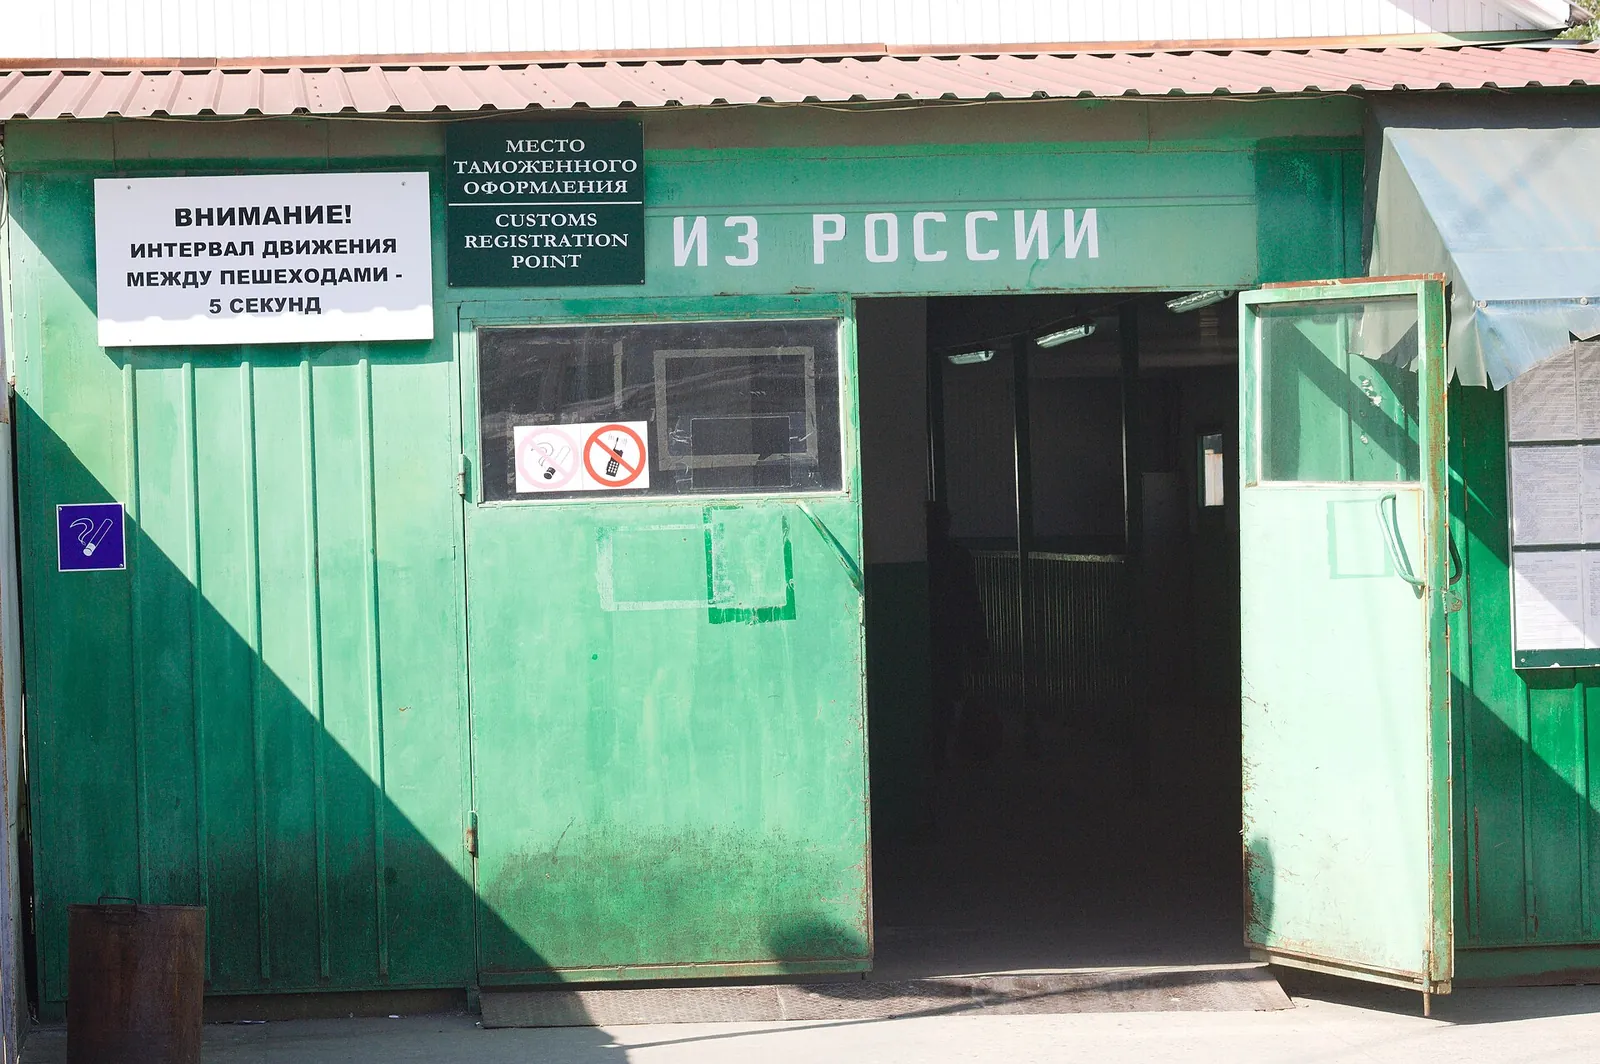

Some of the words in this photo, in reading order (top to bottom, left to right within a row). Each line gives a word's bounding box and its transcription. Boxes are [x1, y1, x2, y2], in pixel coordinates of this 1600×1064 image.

[505, 139, 586, 153] МЕСТО
[453, 159, 637, 174] ТАМОЖЕННОГО
[463, 180, 628, 195] ОФОРМЛЕНИЯ
[174, 204, 352, 227] ВНИМАНИЕ!
[495, 212, 598, 227] CUSTOMS
[464, 233, 629, 249] REGISTRATION
[673, 215, 759, 267] ИЗ
[812, 208, 1100, 264] РОССИИ
[130, 241, 255, 259] ИНТЕРВАЛ
[262, 238, 397, 259] ДВИЖЕНИЯ
[511, 254, 582, 269] POINT
[126, 270, 213, 289] МЕЖДУ
[220, 267, 388, 288] ПЕШЕХОДАМИ
[209, 298, 221, 314] 5
[229, 296, 321, 315] СЕКУНД
